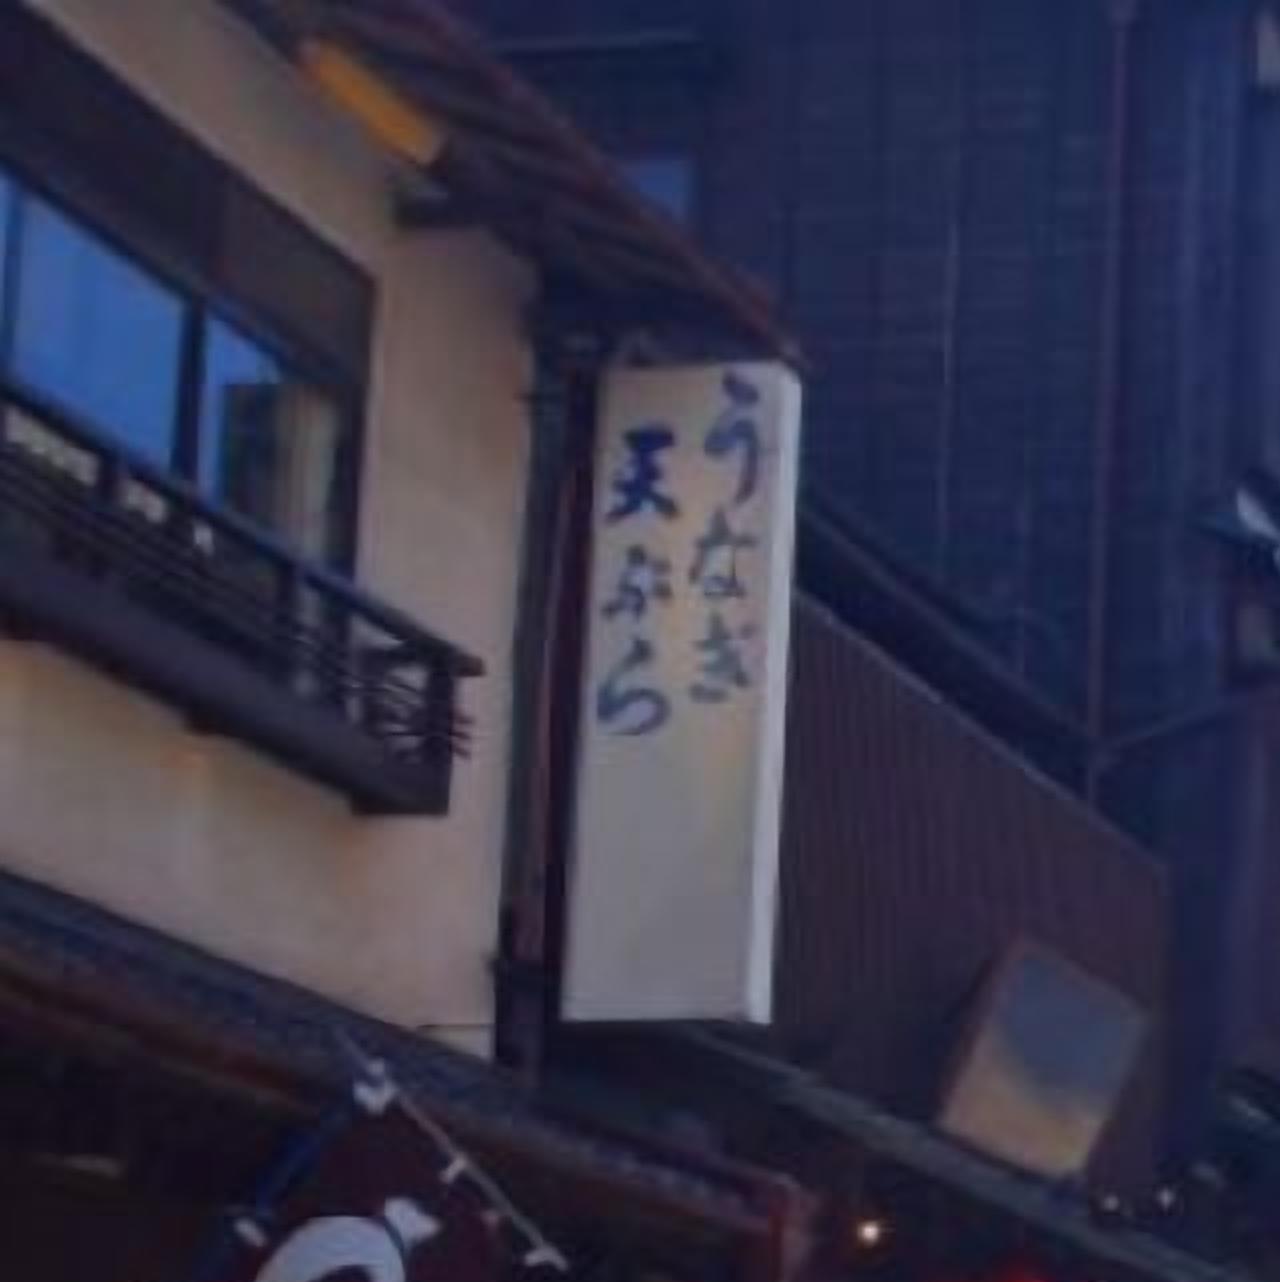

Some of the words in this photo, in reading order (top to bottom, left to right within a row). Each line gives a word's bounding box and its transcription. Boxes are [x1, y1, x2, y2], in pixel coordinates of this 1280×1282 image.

[596, 423, 682, 737] 天ぷら
[689, 370, 760, 702] うなぎ
